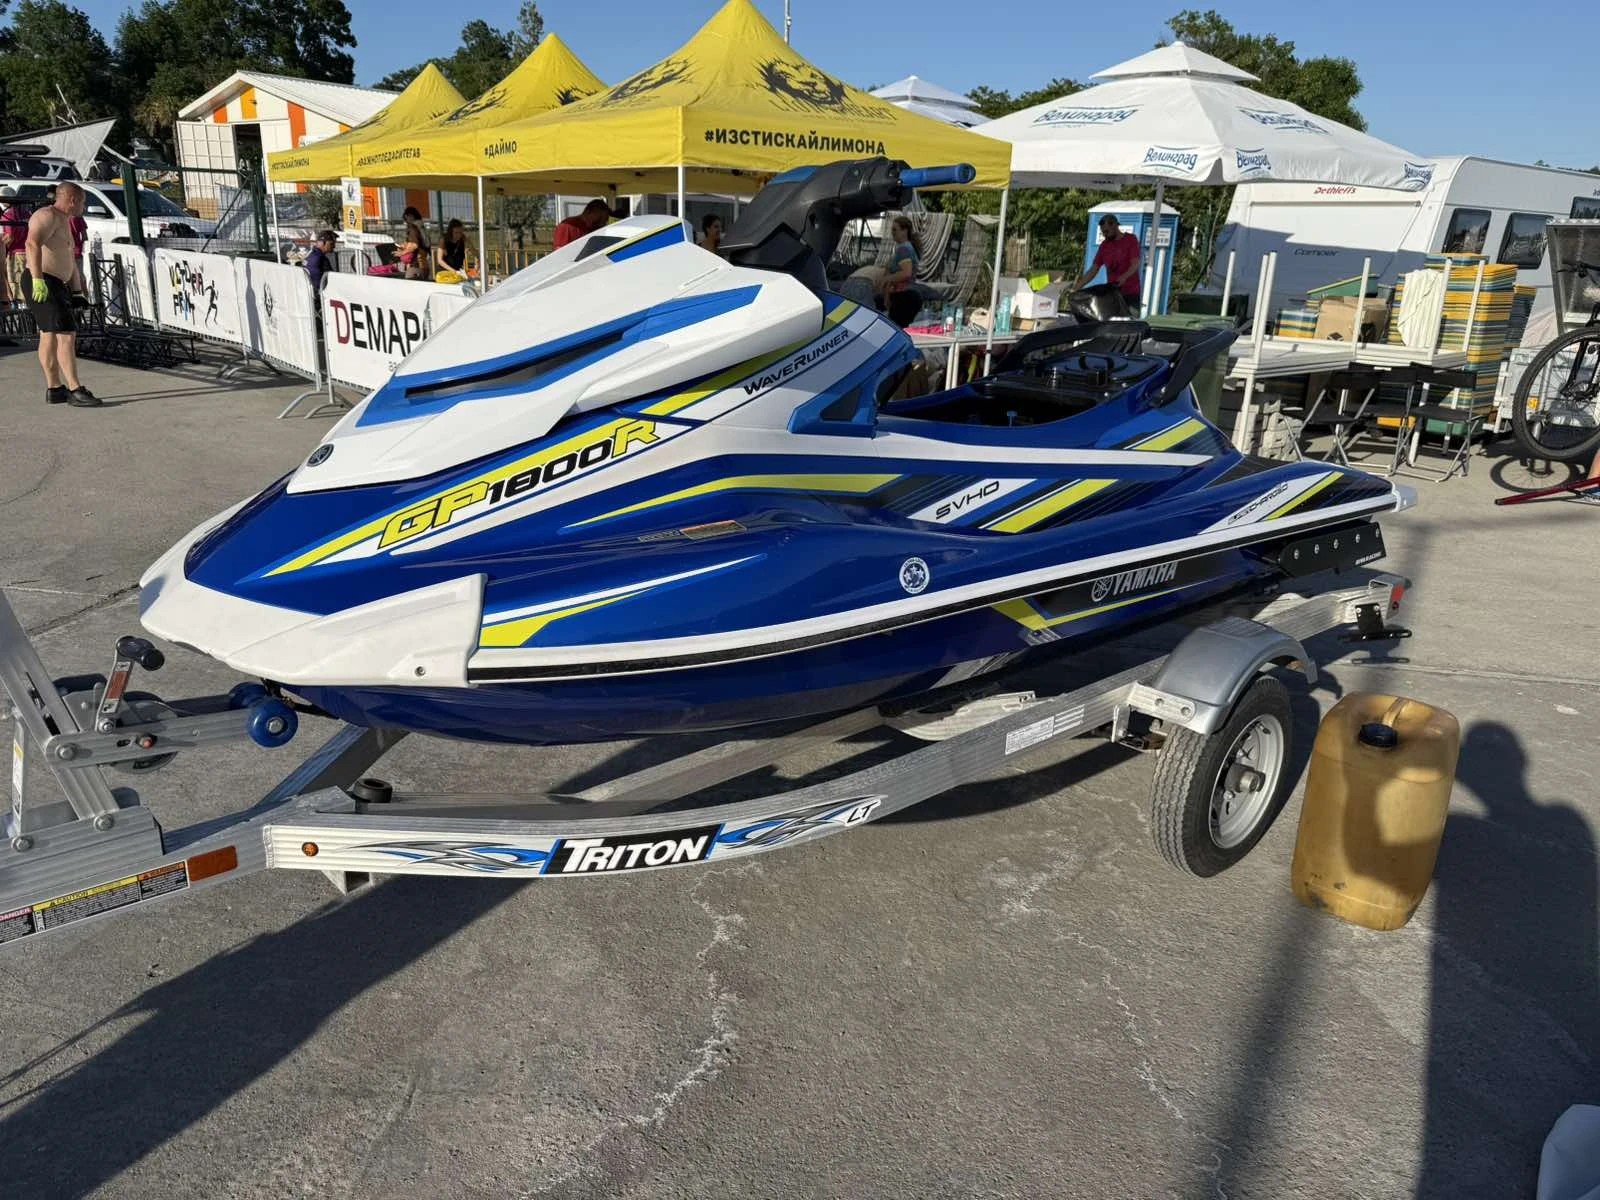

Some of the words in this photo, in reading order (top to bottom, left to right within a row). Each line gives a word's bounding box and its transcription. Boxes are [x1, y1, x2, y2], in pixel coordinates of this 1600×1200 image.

[484, 138, 517, 159] #ДАЙМО
[704, 128, 886, 155] #ИЗСТИСКАЙЛИМОНА
[1143, 147, 1198, 171] Велинград
[1313, 186, 1357, 195] Dethleffs
[329, 298, 428, 357] DEMAP
[377, 418, 661, 550] GP1800R
[935, 480, 1000, 520] SVHO
[1112, 562, 1178, 596] YAMAHA
[846, 803, 873, 824] LT
[562, 834, 708, 873] TRITON
